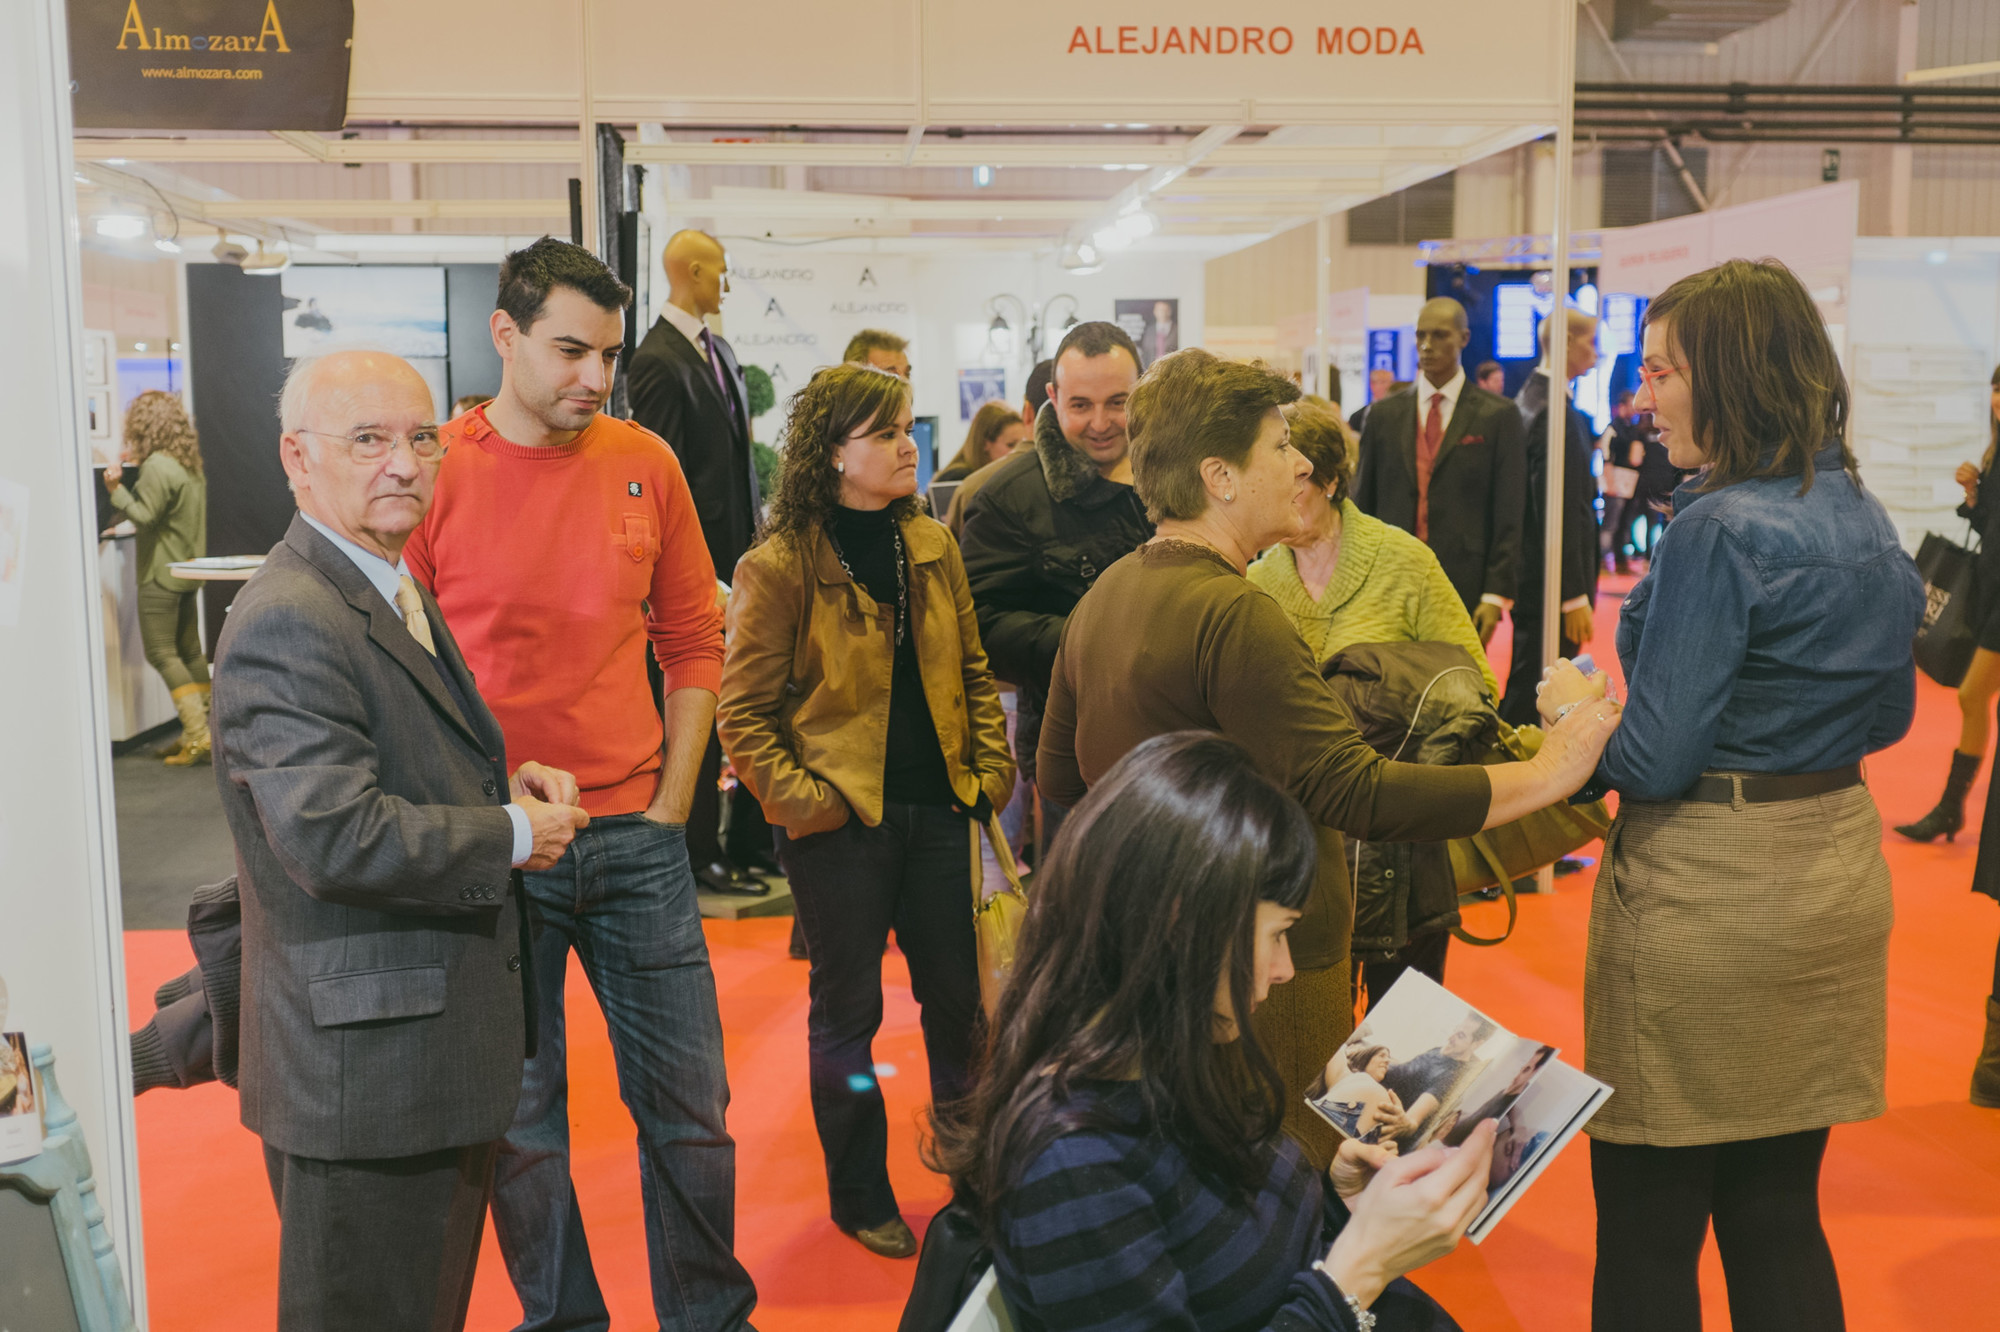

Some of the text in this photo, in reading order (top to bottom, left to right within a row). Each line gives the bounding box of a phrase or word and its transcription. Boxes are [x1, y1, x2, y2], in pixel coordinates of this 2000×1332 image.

[1067, 26, 1425, 55] ALEJANDRO MODA
[141, 66, 263, 80] www.almozara.com
